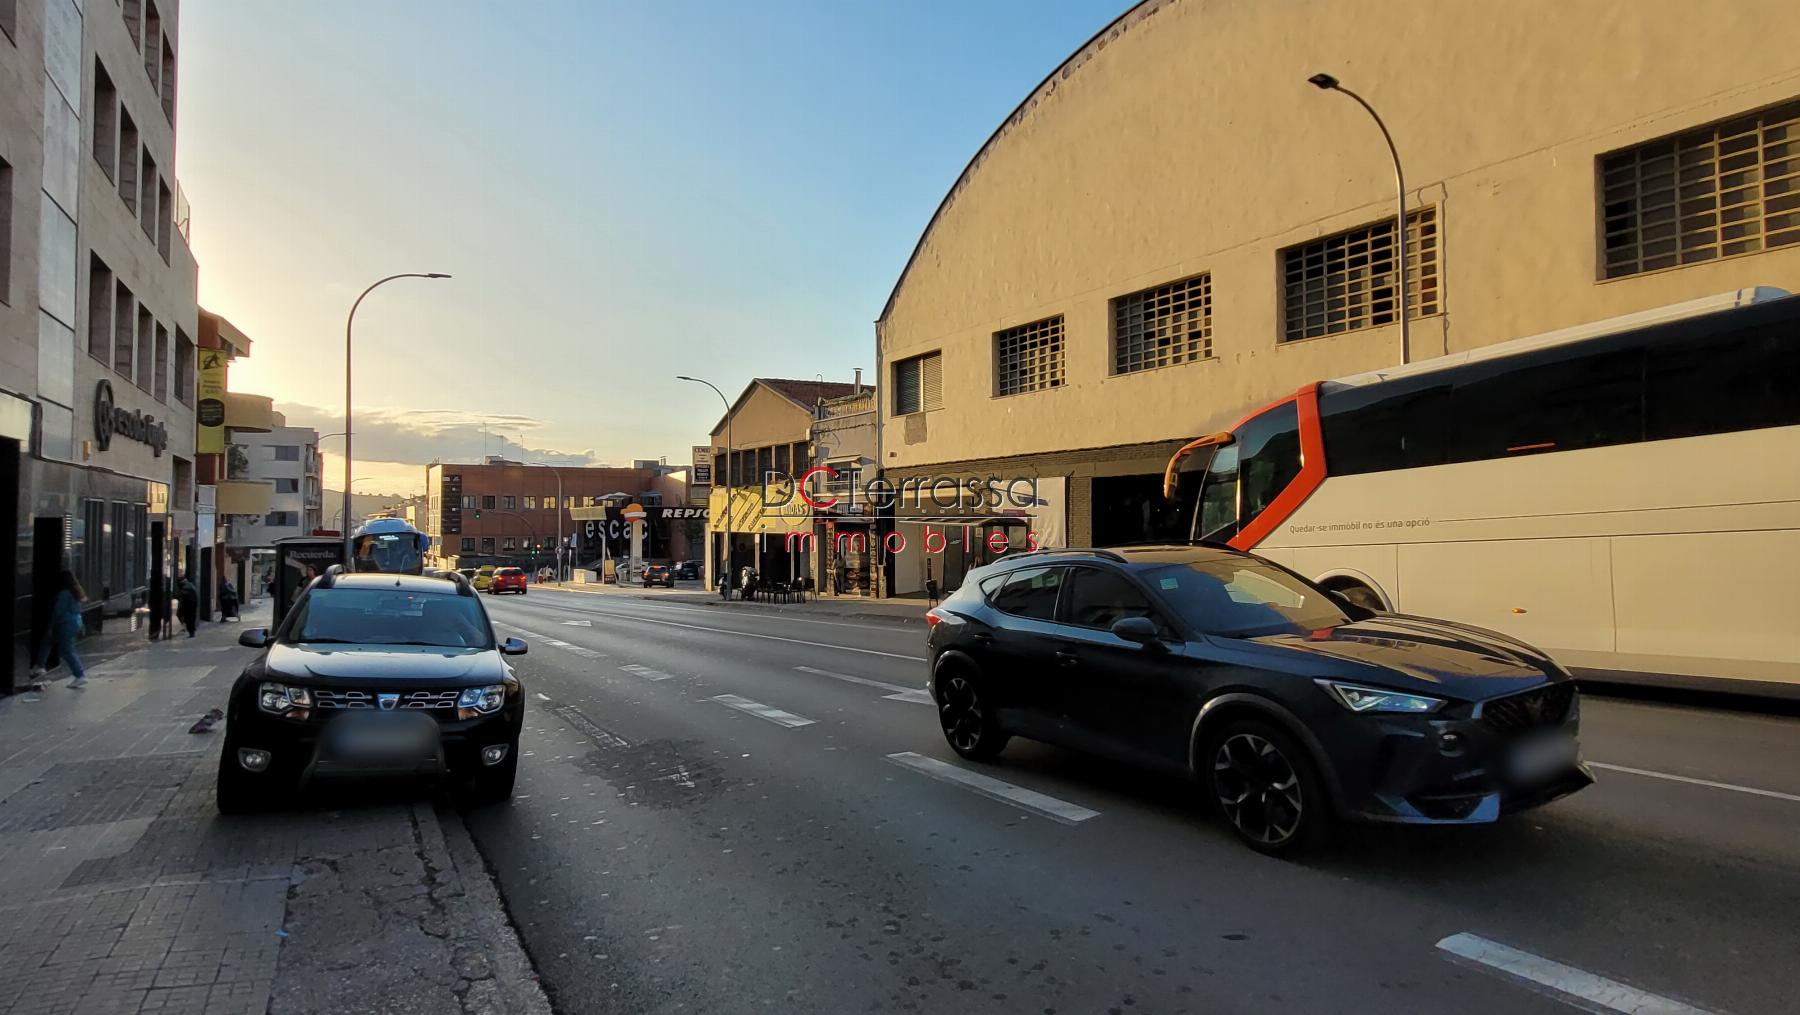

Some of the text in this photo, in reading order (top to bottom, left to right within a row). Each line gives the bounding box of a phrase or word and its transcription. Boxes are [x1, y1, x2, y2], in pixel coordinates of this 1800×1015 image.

[1290, 525, 1327, 534] Quedar-se
[1363, 522, 1373, 530] no
[1387, 520, 1403, 529] una
[1405, 517, 1430, 529] opció
